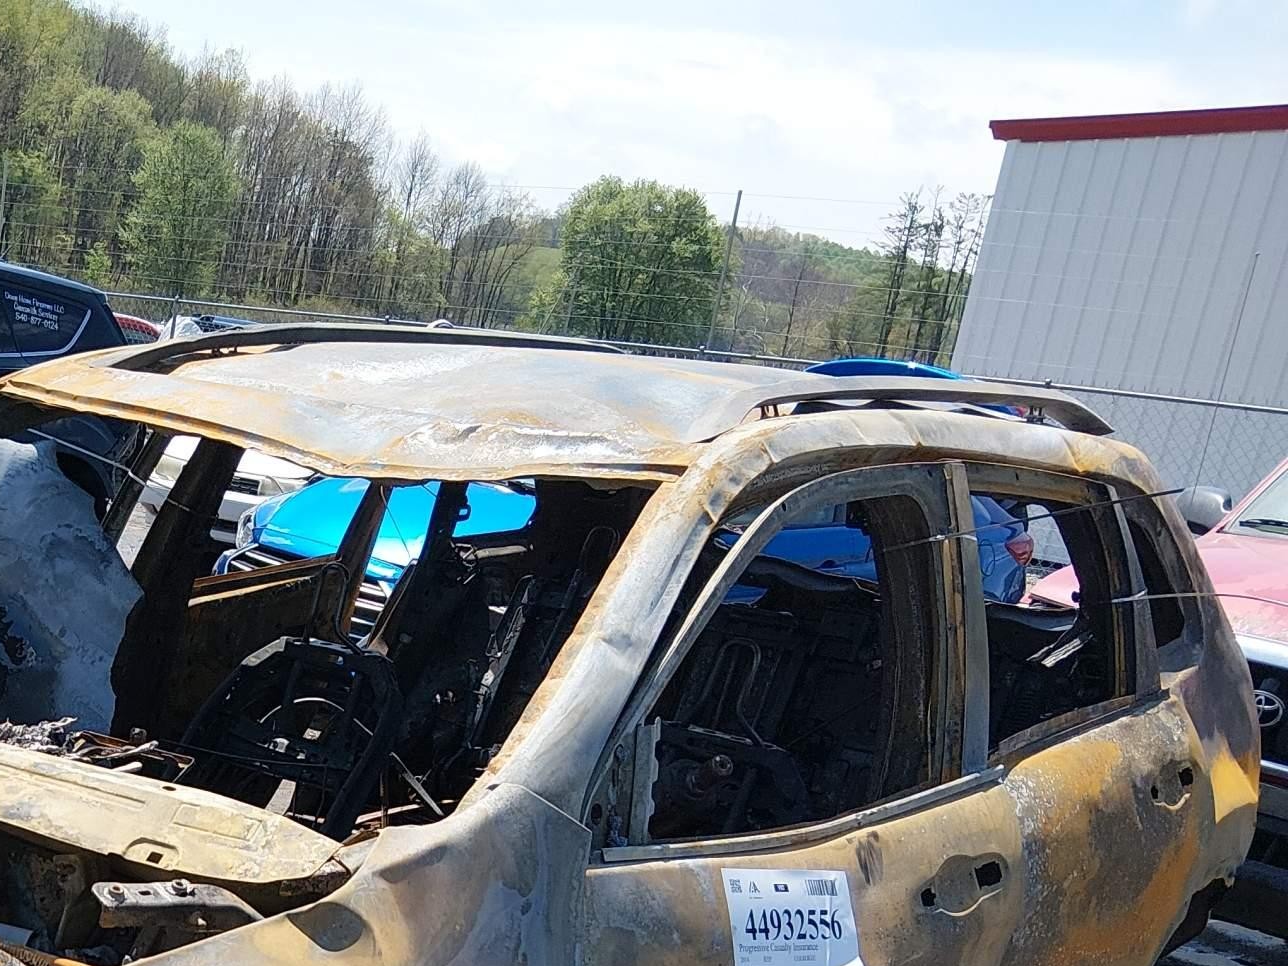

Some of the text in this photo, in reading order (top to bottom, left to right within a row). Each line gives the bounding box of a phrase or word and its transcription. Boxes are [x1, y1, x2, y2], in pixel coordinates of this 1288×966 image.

[53, 303, 65, 314] LLC
[745, 908, 842, 941] 44932556
[739, 943, 769, 954] Progressive
[793, 942, 819, 952] Insurance
